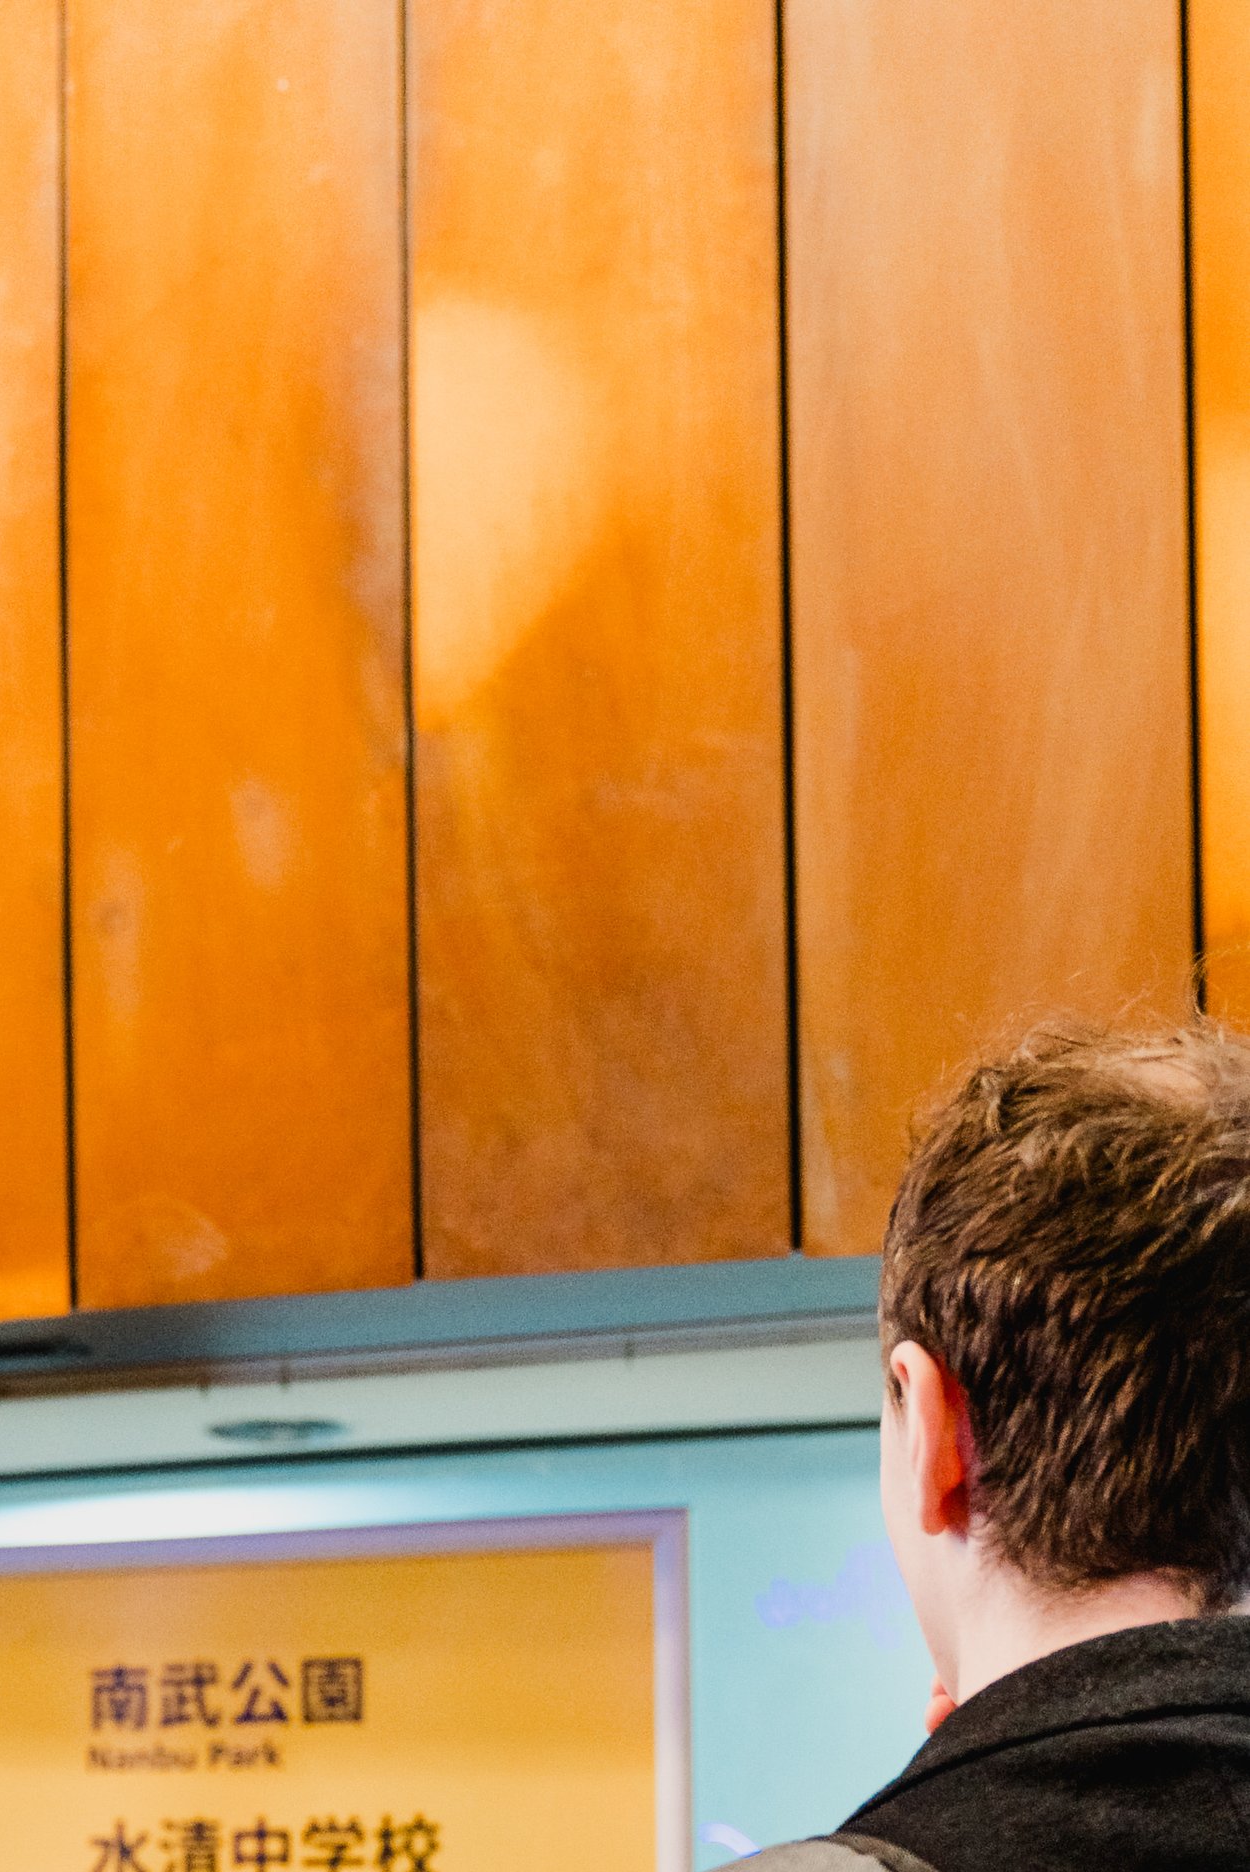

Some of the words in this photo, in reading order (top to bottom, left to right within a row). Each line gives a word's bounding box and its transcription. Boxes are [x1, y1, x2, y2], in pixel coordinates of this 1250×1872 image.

[89, 1657, 364, 1730] 南武公園
[207, 1740, 282, 1769] Park
